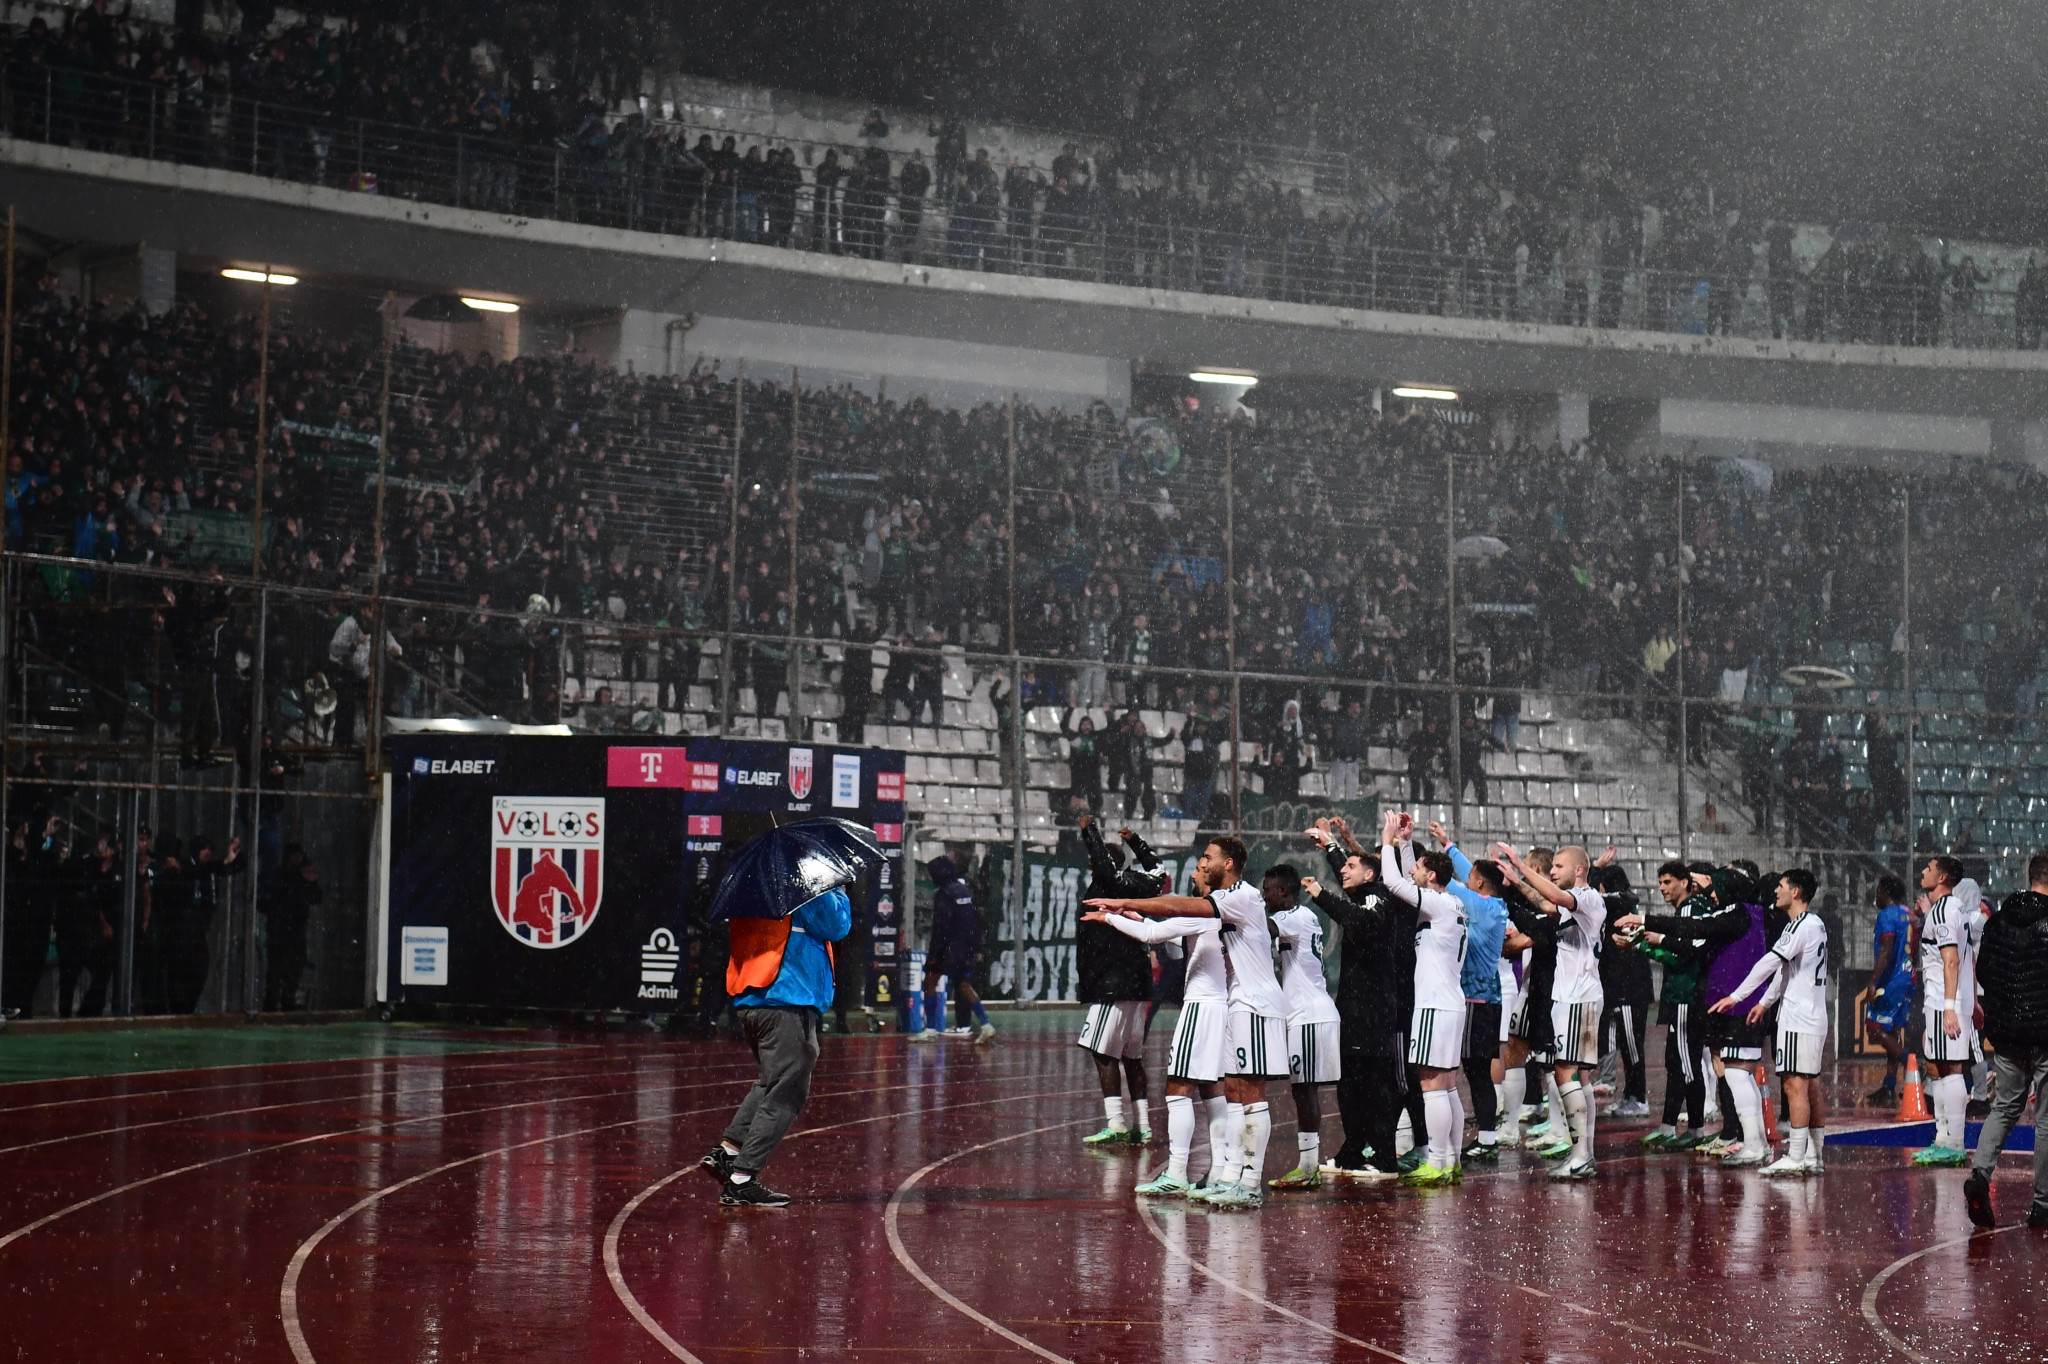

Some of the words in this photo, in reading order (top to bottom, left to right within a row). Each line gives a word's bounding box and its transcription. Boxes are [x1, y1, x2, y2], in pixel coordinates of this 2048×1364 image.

[430, 759, 496, 774] ELABET
[640, 752, 662, 783] T
[737, 769, 781, 787] ELABET
[1510, 1012, 1518, 1030] 6
[1236, 1046, 1247, 1069] 9
